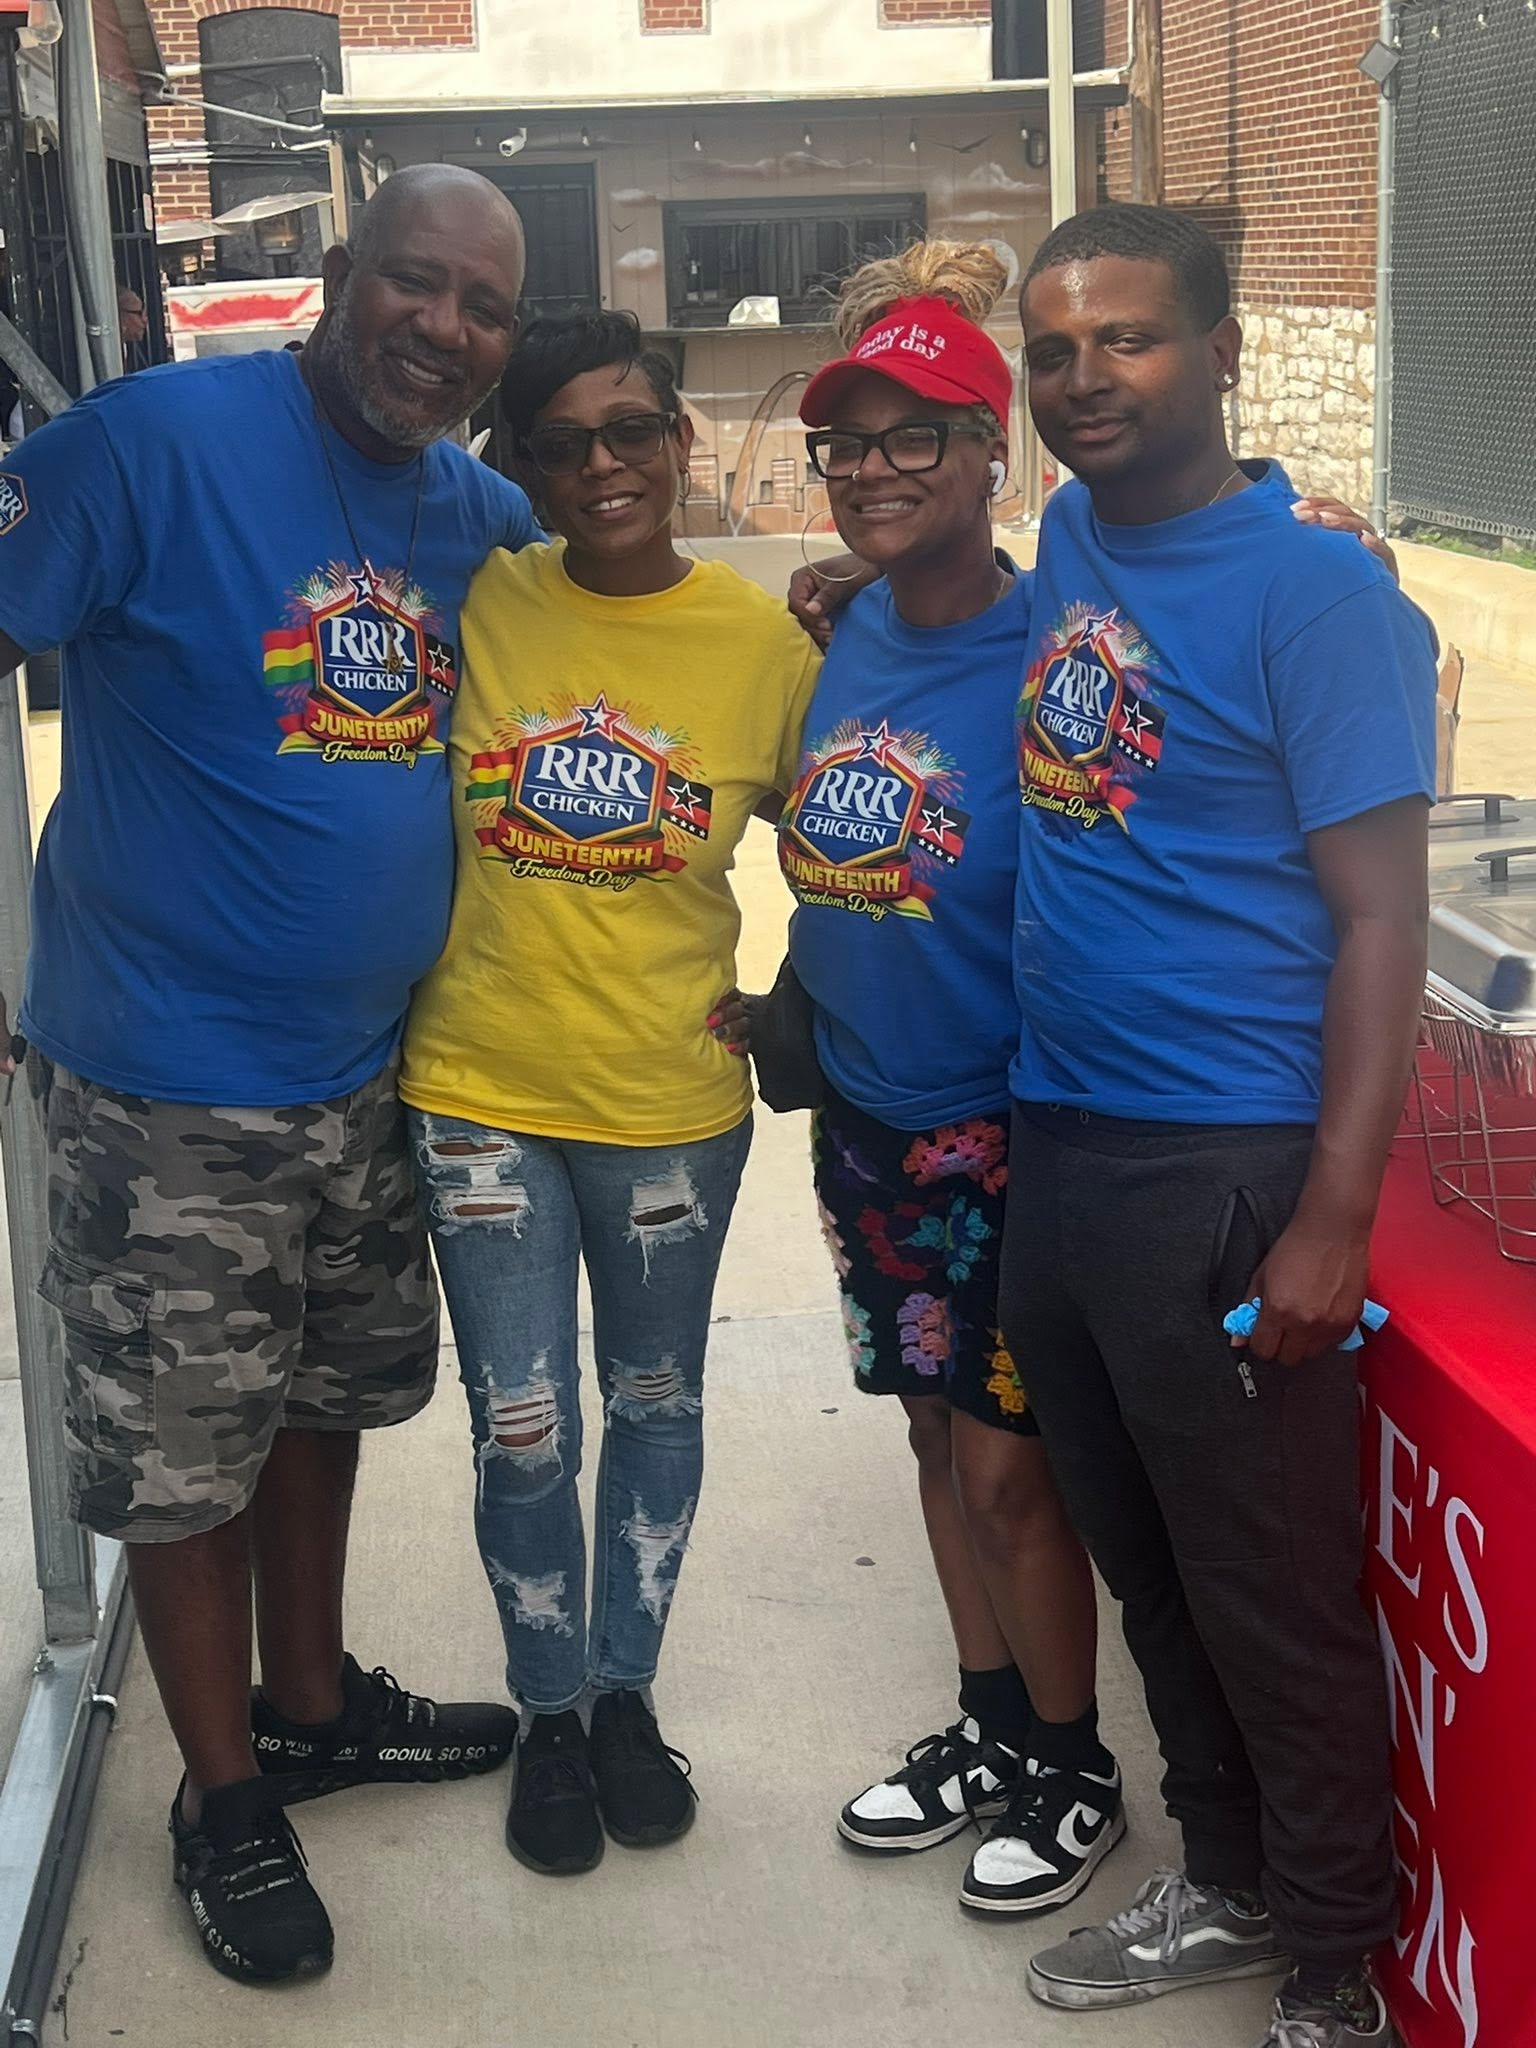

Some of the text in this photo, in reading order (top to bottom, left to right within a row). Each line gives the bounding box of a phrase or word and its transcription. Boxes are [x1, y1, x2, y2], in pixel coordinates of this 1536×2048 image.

[856, 323, 946, 357] oday is a
[862, 336, 940, 360] ood day
[329, 617, 416, 667] RRR
[333, 670, 407, 692] CHICKEN
[1048, 656, 1108, 719] RRR
[310, 709, 429, 740] JUNETEENTH
[1040, 709, 1097, 746] CHICKEN
[322, 741, 417, 769] Freedom Day
[535, 744, 649, 799] RRR
[1024, 748, 1101, 794] JUNETEEN
[532, 790, 635, 822] CHICKEN
[811, 768, 902, 822] RRR
[1021, 784, 1101, 829] Freedom Day
[501, 826, 652, 866] JUNETEENTH
[802, 815, 887, 845] CHICKEN
[511, 857, 637, 892] Freedom Day
[785, 851, 900, 892] JUNETEENTH
[800, 884, 888, 922] reedom Day
[1358, 1382, 1487, 1674] E'S
[257, 1736, 282, 1751] SO
[437, 1747, 461, 1761] SO
[464, 1746, 486, 1760] SO
